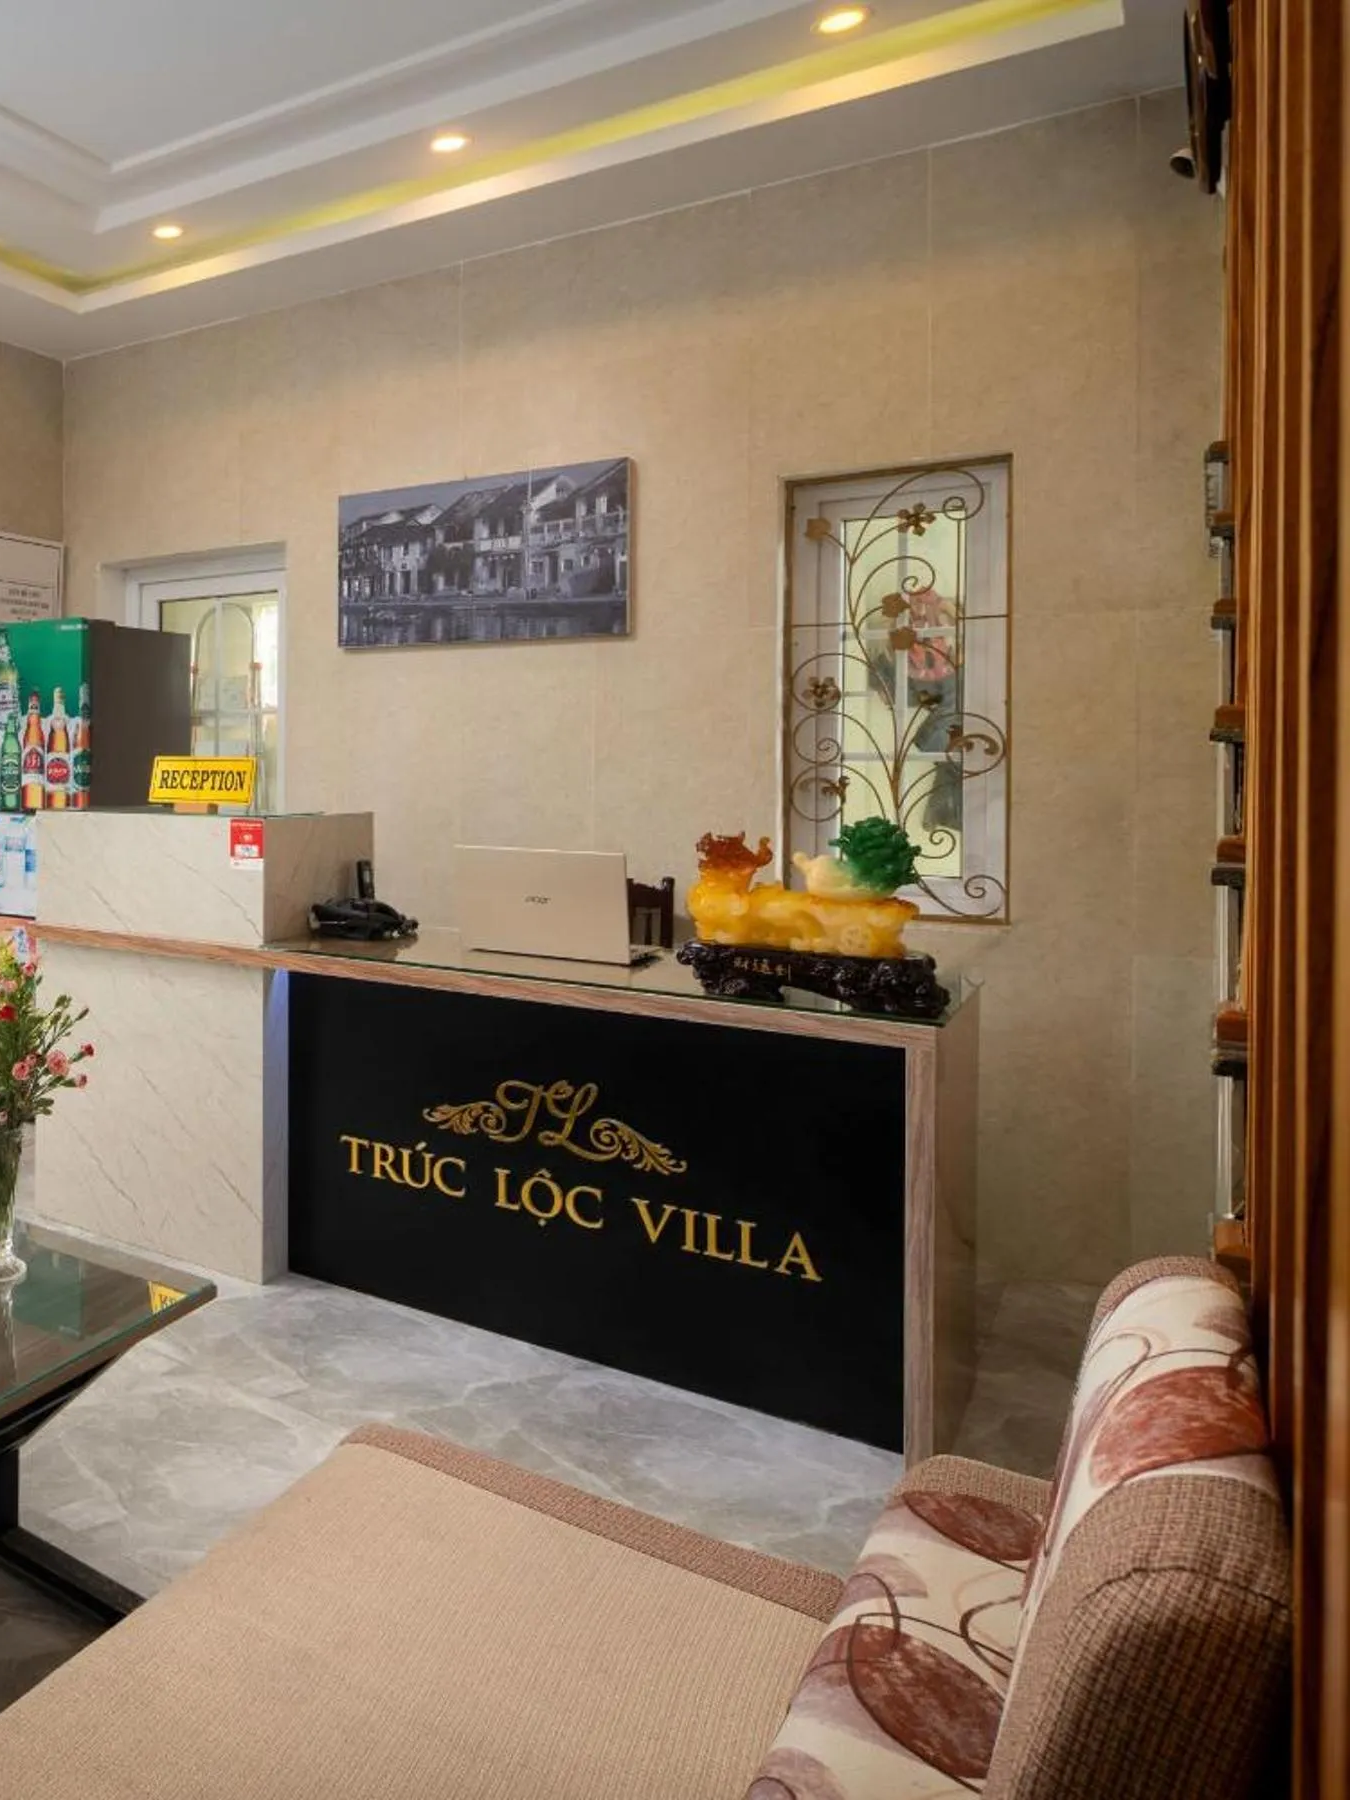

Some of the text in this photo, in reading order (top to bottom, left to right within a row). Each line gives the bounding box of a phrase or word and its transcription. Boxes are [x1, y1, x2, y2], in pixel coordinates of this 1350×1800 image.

[159, 769, 247, 791] RECEPTION
[340, 1135, 823, 1281] TRÚC LỘC VILLA
